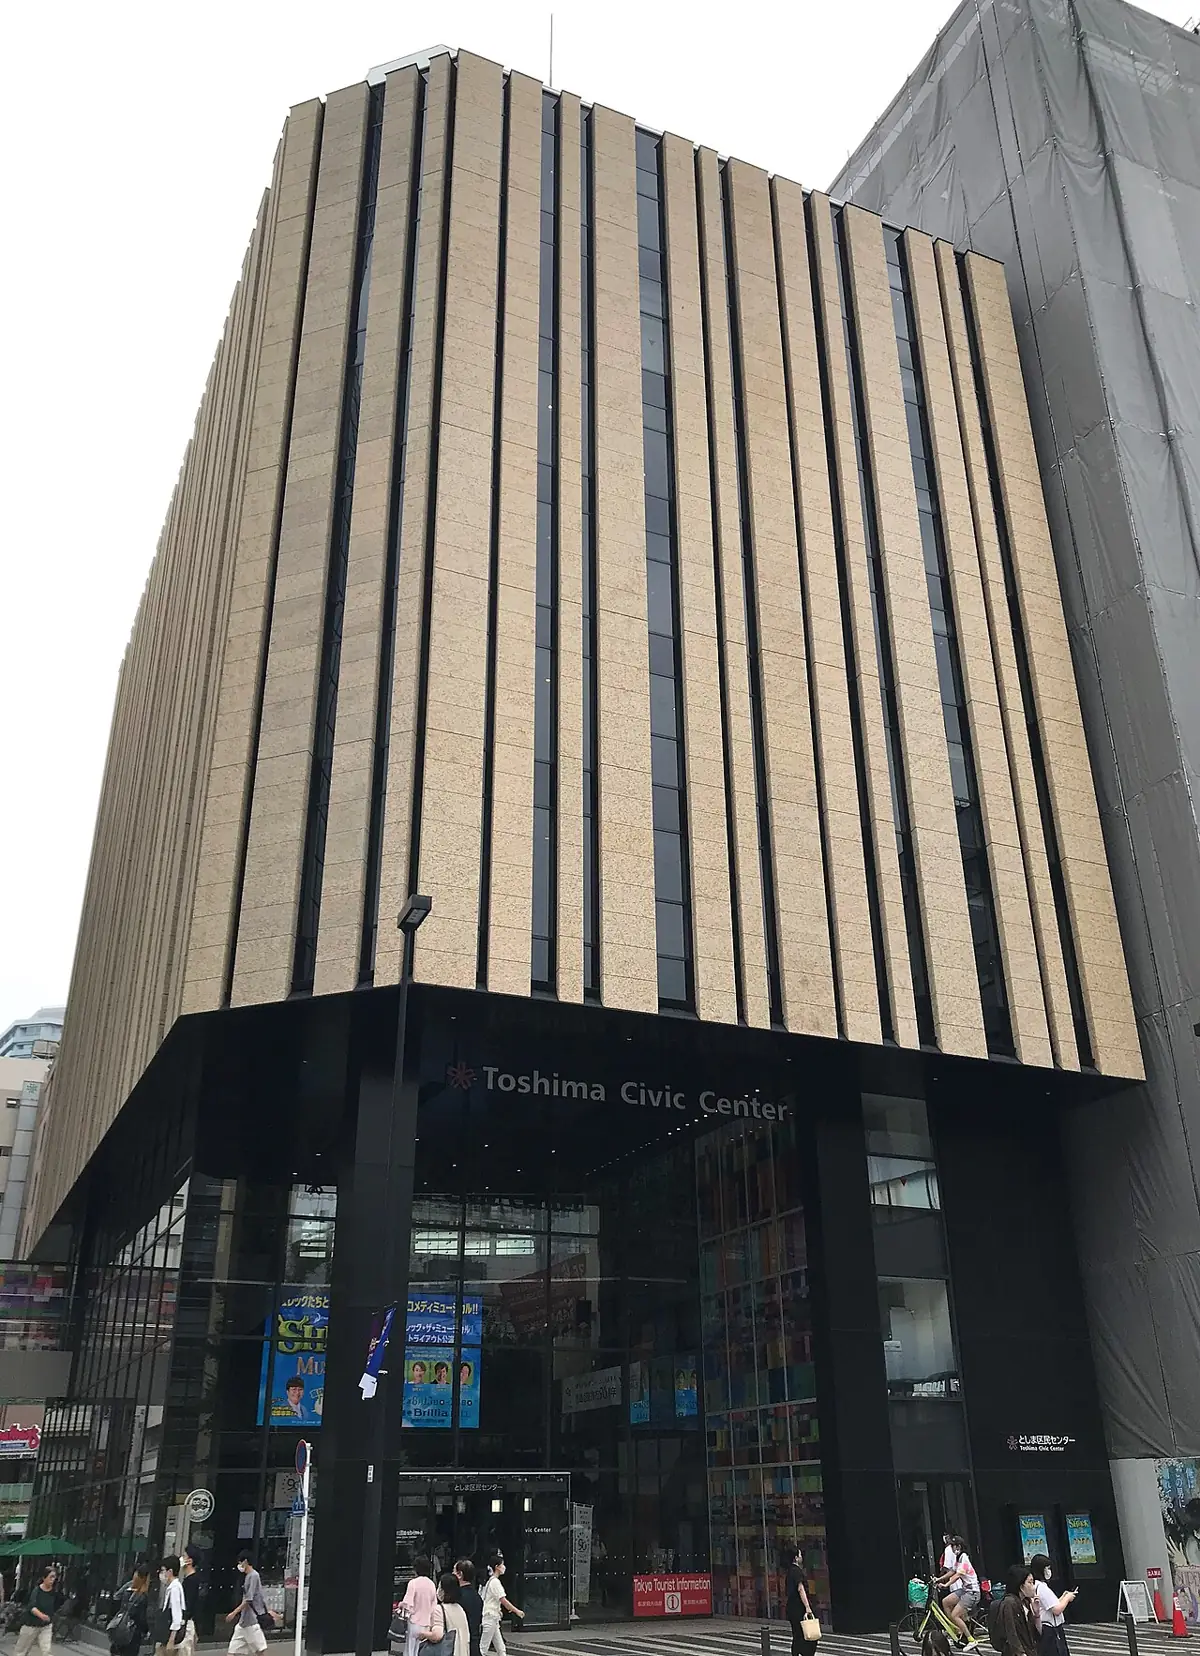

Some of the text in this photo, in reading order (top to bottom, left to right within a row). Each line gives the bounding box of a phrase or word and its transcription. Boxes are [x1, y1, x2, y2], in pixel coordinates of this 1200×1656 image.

[482, 1066, 787, 1121] Toshima Civic Center
[1018, 1435, 1076, 1445] としま区民センター
[454, 1483, 503, 1492] としま区民センター
[633, 1576, 711, 1594] Tokyo Tourist Information
